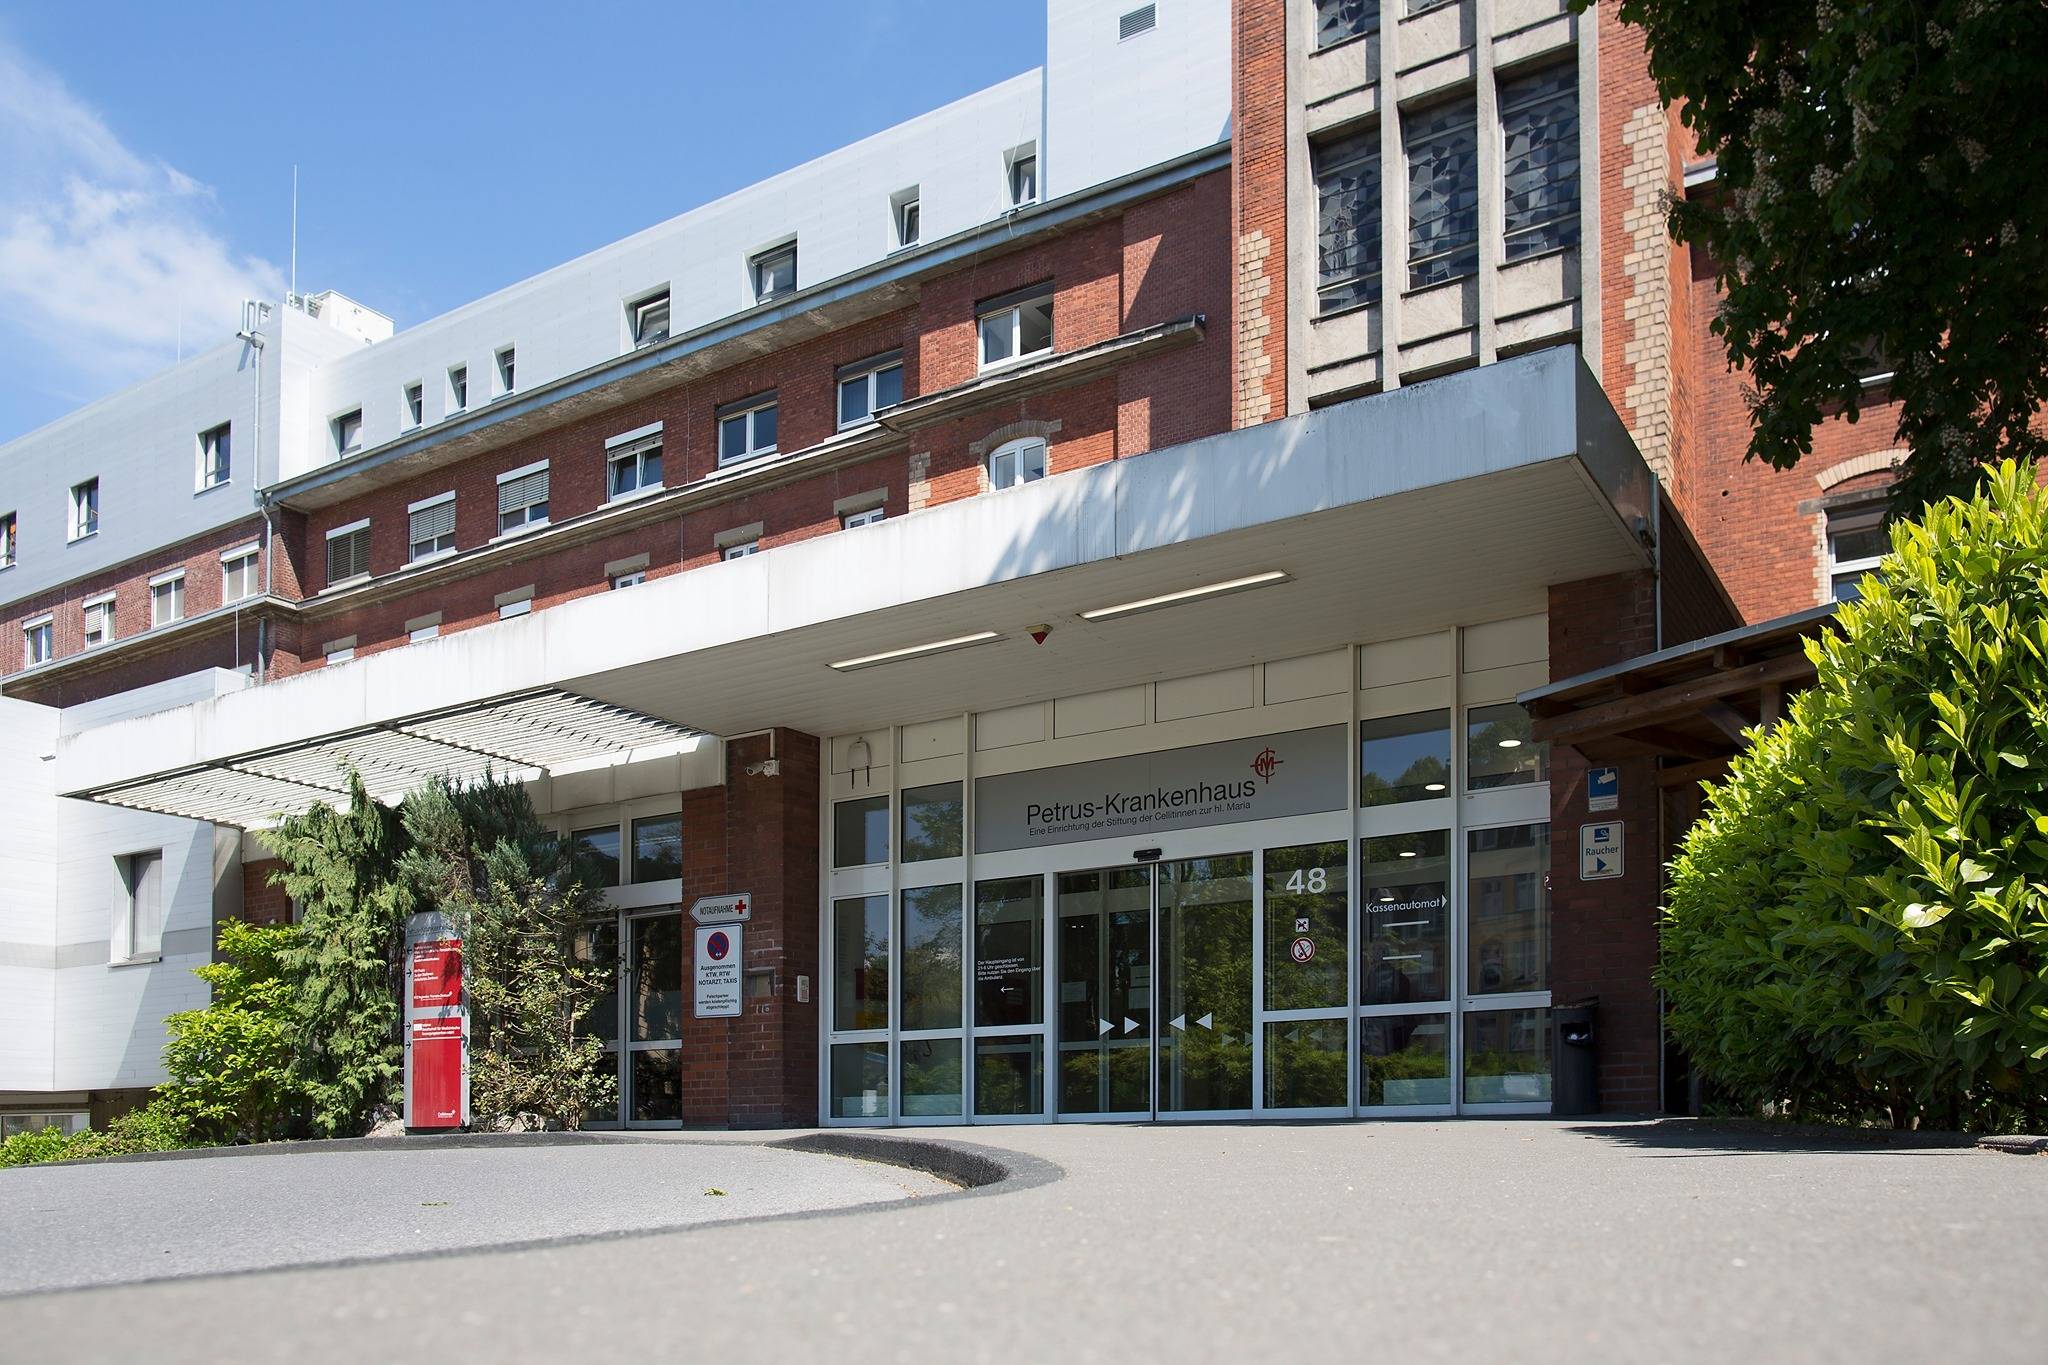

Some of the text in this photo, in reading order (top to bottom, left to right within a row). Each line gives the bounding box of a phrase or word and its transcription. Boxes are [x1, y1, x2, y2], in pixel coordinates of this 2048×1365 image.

[1027, 780, 1256, 825] Petrus-Krankenhaus
[1029, 802, 1251, 836] Eine Einrichtung der Stiftung der Cellitinnen zur hl. Maria
[1585, 845, 1619, 856] Raucher
[1286, 867, 1327, 895] 48
[700, 904, 734, 915] NOTAUFNAHME
[1366, 898, 1440, 914] Kassenautomat
